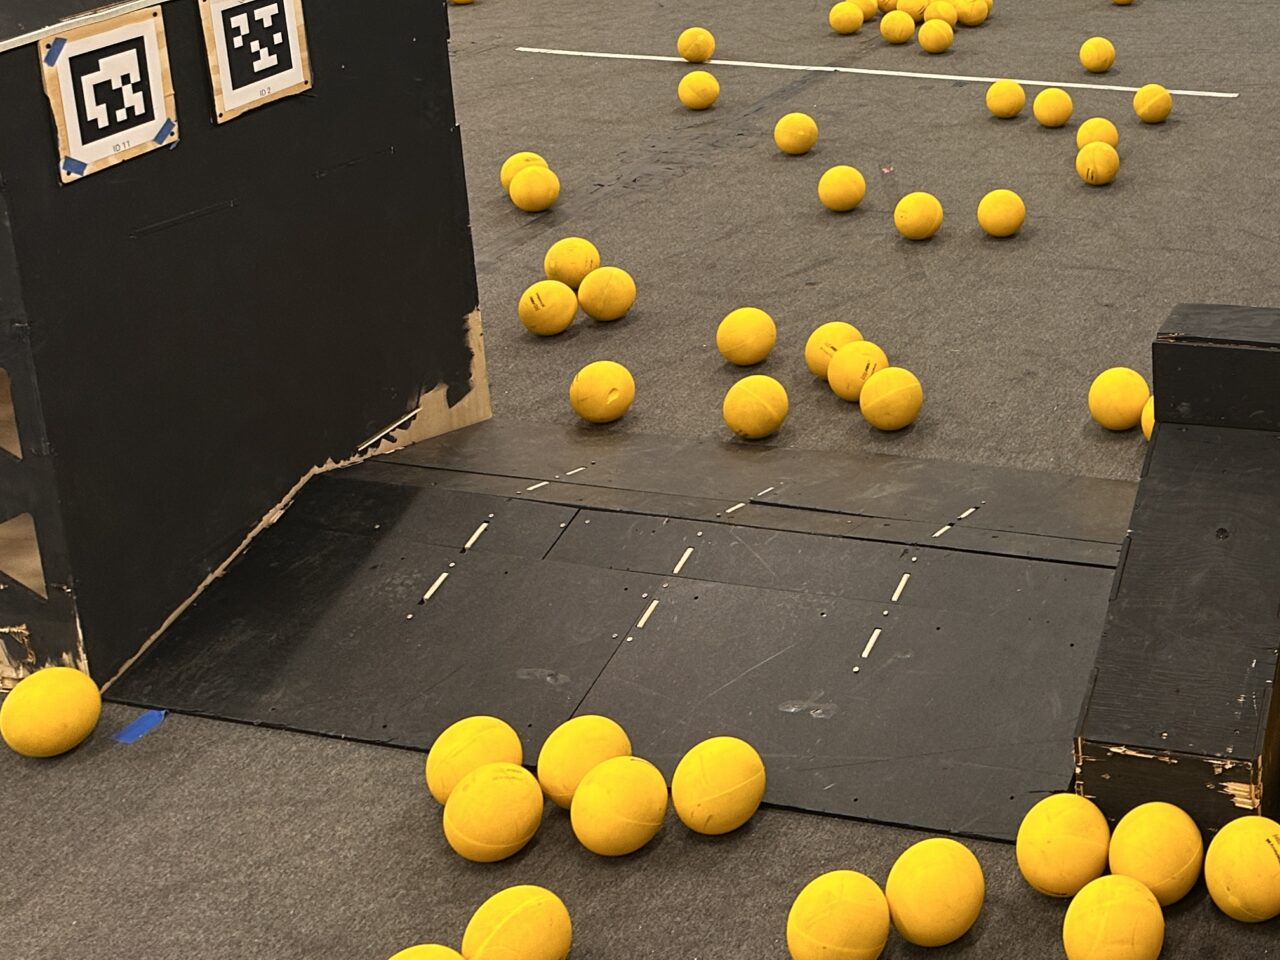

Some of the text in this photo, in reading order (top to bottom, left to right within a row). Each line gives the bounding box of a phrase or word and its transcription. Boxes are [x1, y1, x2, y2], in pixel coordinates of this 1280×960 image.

[259, 89, 267, 97] ID
[112, 141, 132, 154] ID 11
